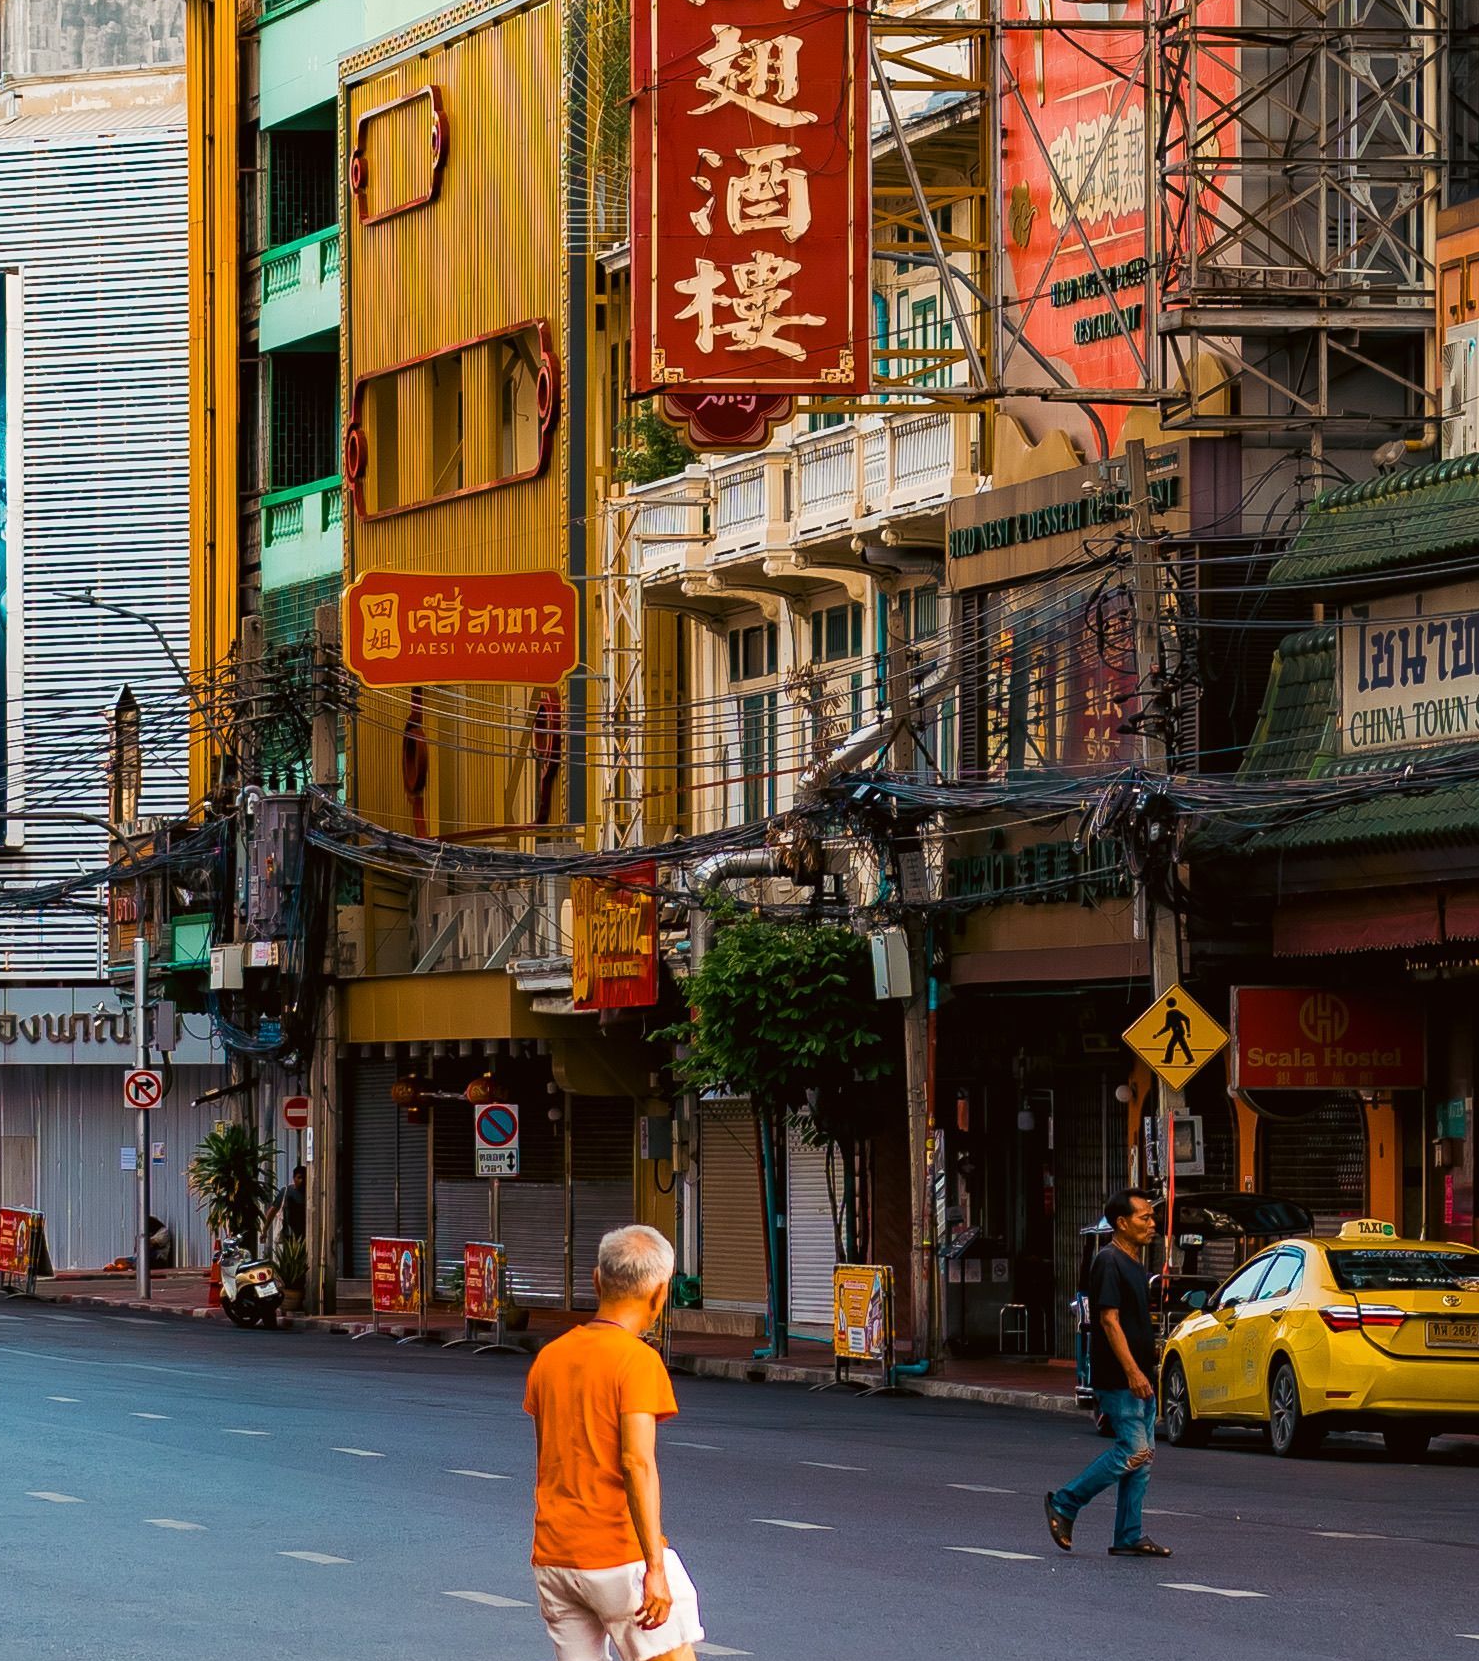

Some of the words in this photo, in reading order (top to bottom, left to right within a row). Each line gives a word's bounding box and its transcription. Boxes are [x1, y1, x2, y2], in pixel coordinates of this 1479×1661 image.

[949, 527, 975, 559] BIRD
[979, 518, 1010, 552] NEST
[1027, 500, 1081, 541] DESSERT
[366, 597, 398, 651] 四姐
[468, 604, 538, 636] สาขา
[541, 605, 565, 635] 2
[408, 642, 455, 655] JAESI
[465, 641, 563, 654] YAOWARAT
[1350, 706, 1406, 748] CHINA
[1413, 696, 1469, 739] TOWN
[1247, 1047, 1319, 1068] Scala
[1324, 1047, 1403, 1067] Hostel
[1357, 1221, 1383, 1234] TAXI
